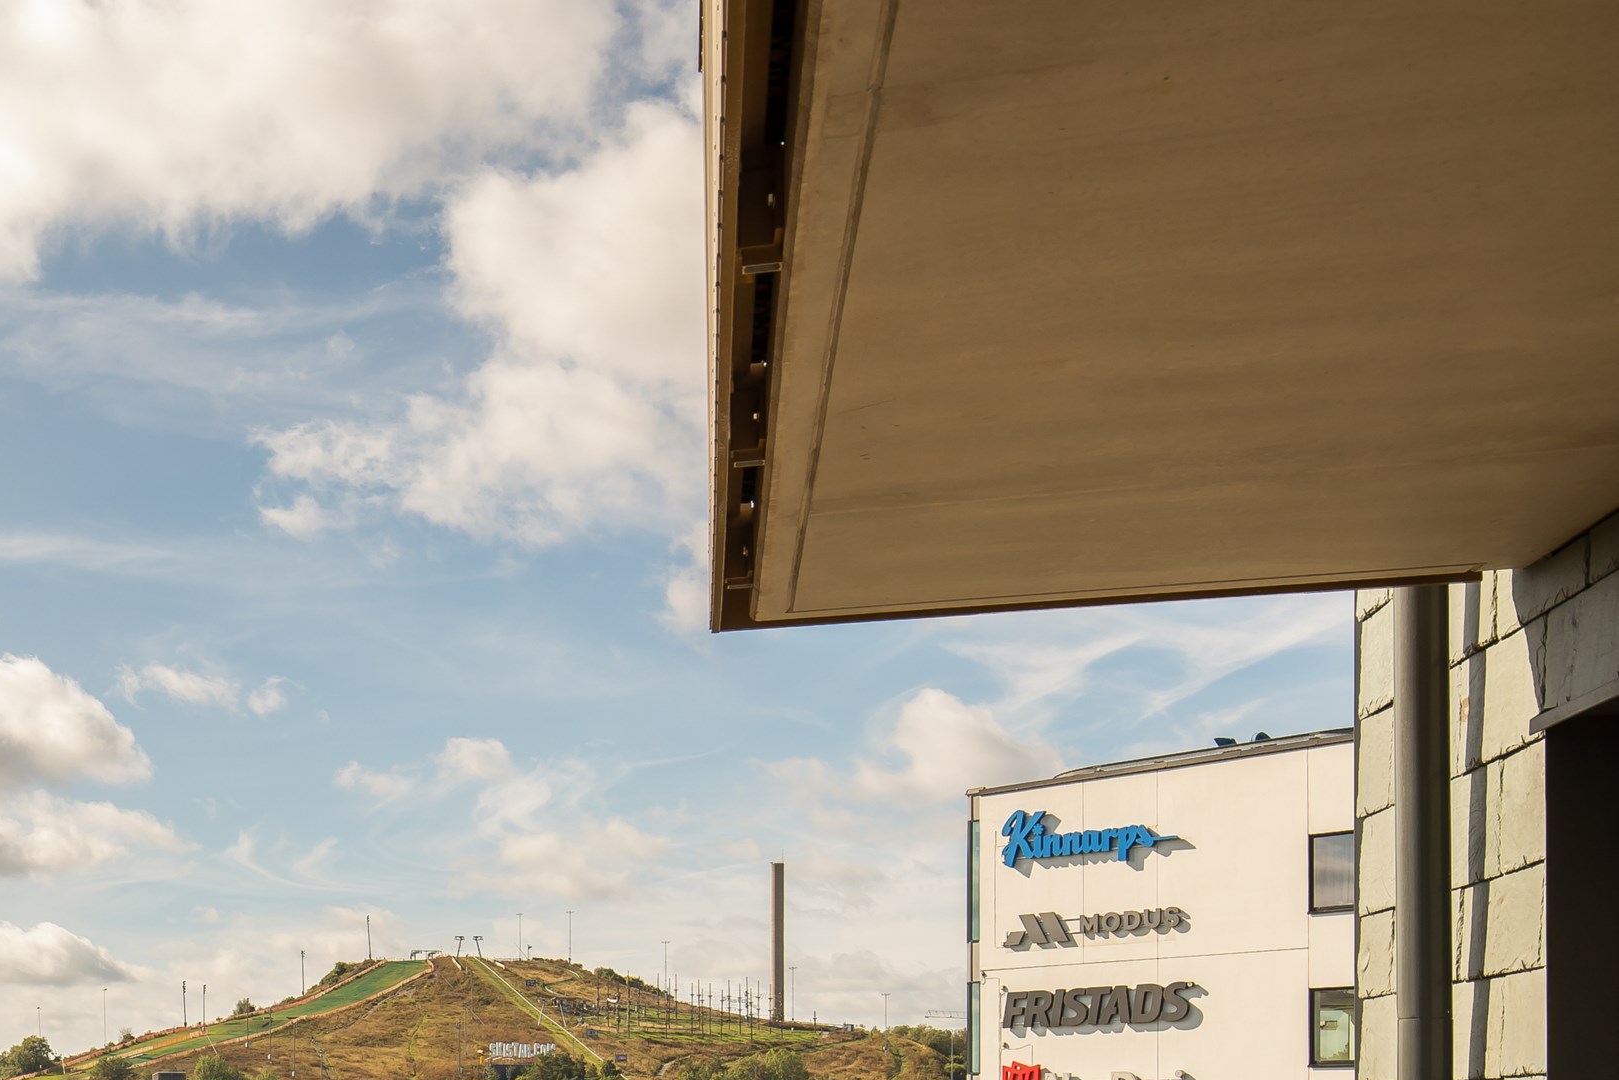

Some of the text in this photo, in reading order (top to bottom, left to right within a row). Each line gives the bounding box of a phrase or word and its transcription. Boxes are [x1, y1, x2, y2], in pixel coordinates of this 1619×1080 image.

[1002, 810, 1179, 868] Kinnarps
[1079, 907, 1182, 934] MODUS
[1003, 981, 1191, 1028] FRISTADS
